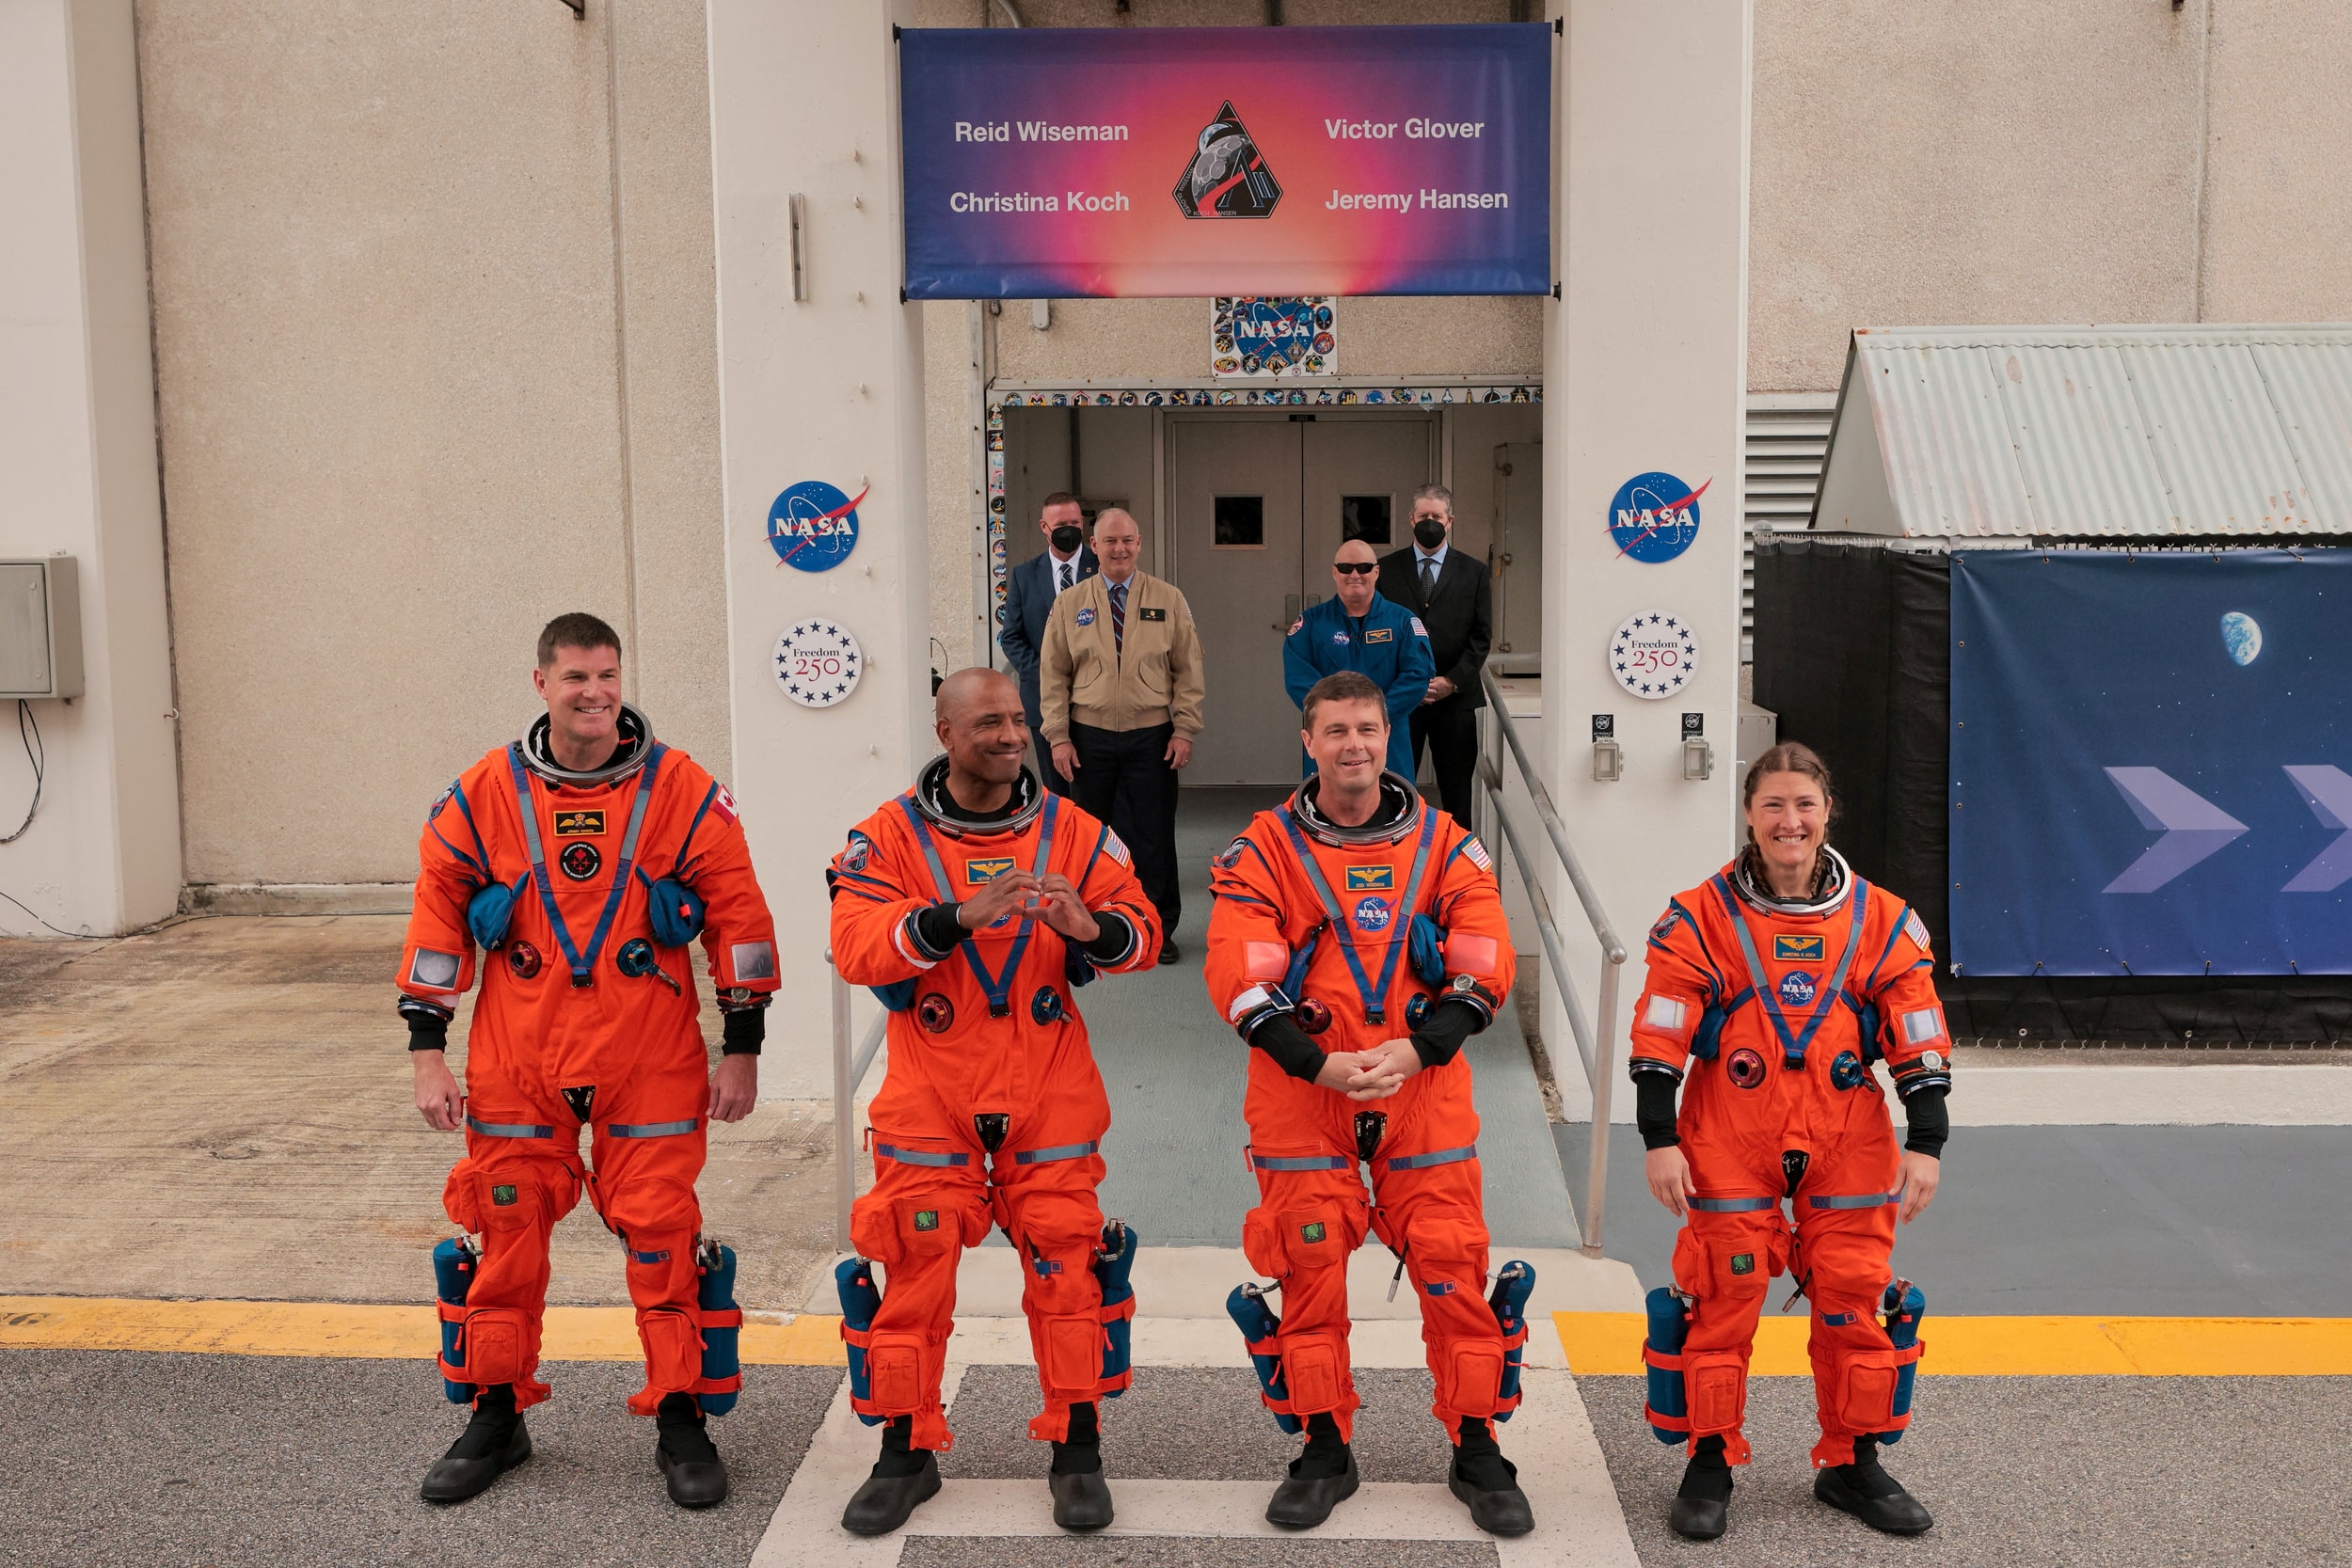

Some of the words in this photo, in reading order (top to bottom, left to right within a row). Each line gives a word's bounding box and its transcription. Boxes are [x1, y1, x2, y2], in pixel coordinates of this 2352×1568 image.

[955, 121, 1009, 142] Reid
[1016, 121, 1128, 142] Wiseman
[1325, 119, 1398, 139] Victor
[1405, 118, 1485, 139] Glover
[1178, 166, 1195, 192] WISEMAN
[950, 191, 1059, 213] Christina
[1067, 191, 1130, 212] Koch
[1177, 193, 1192, 214] GLOVER
[1325, 189, 1413, 214] Jeremy
[1420, 188, 1508, 209] Hansen
[1240, 320, 1311, 338] NASA
[774, 517, 854, 536] NASA
[1616, 509, 1695, 528] NASA
[793, 648, 840, 657] Freedom
[1630, 640, 1678, 648] Freedom
[794, 657, 841, 682] 250
[1631, 650, 1678, 673] 250
[1358, 909, 1389, 919] NASA
[1782, 984, 1814, 993] NASA
